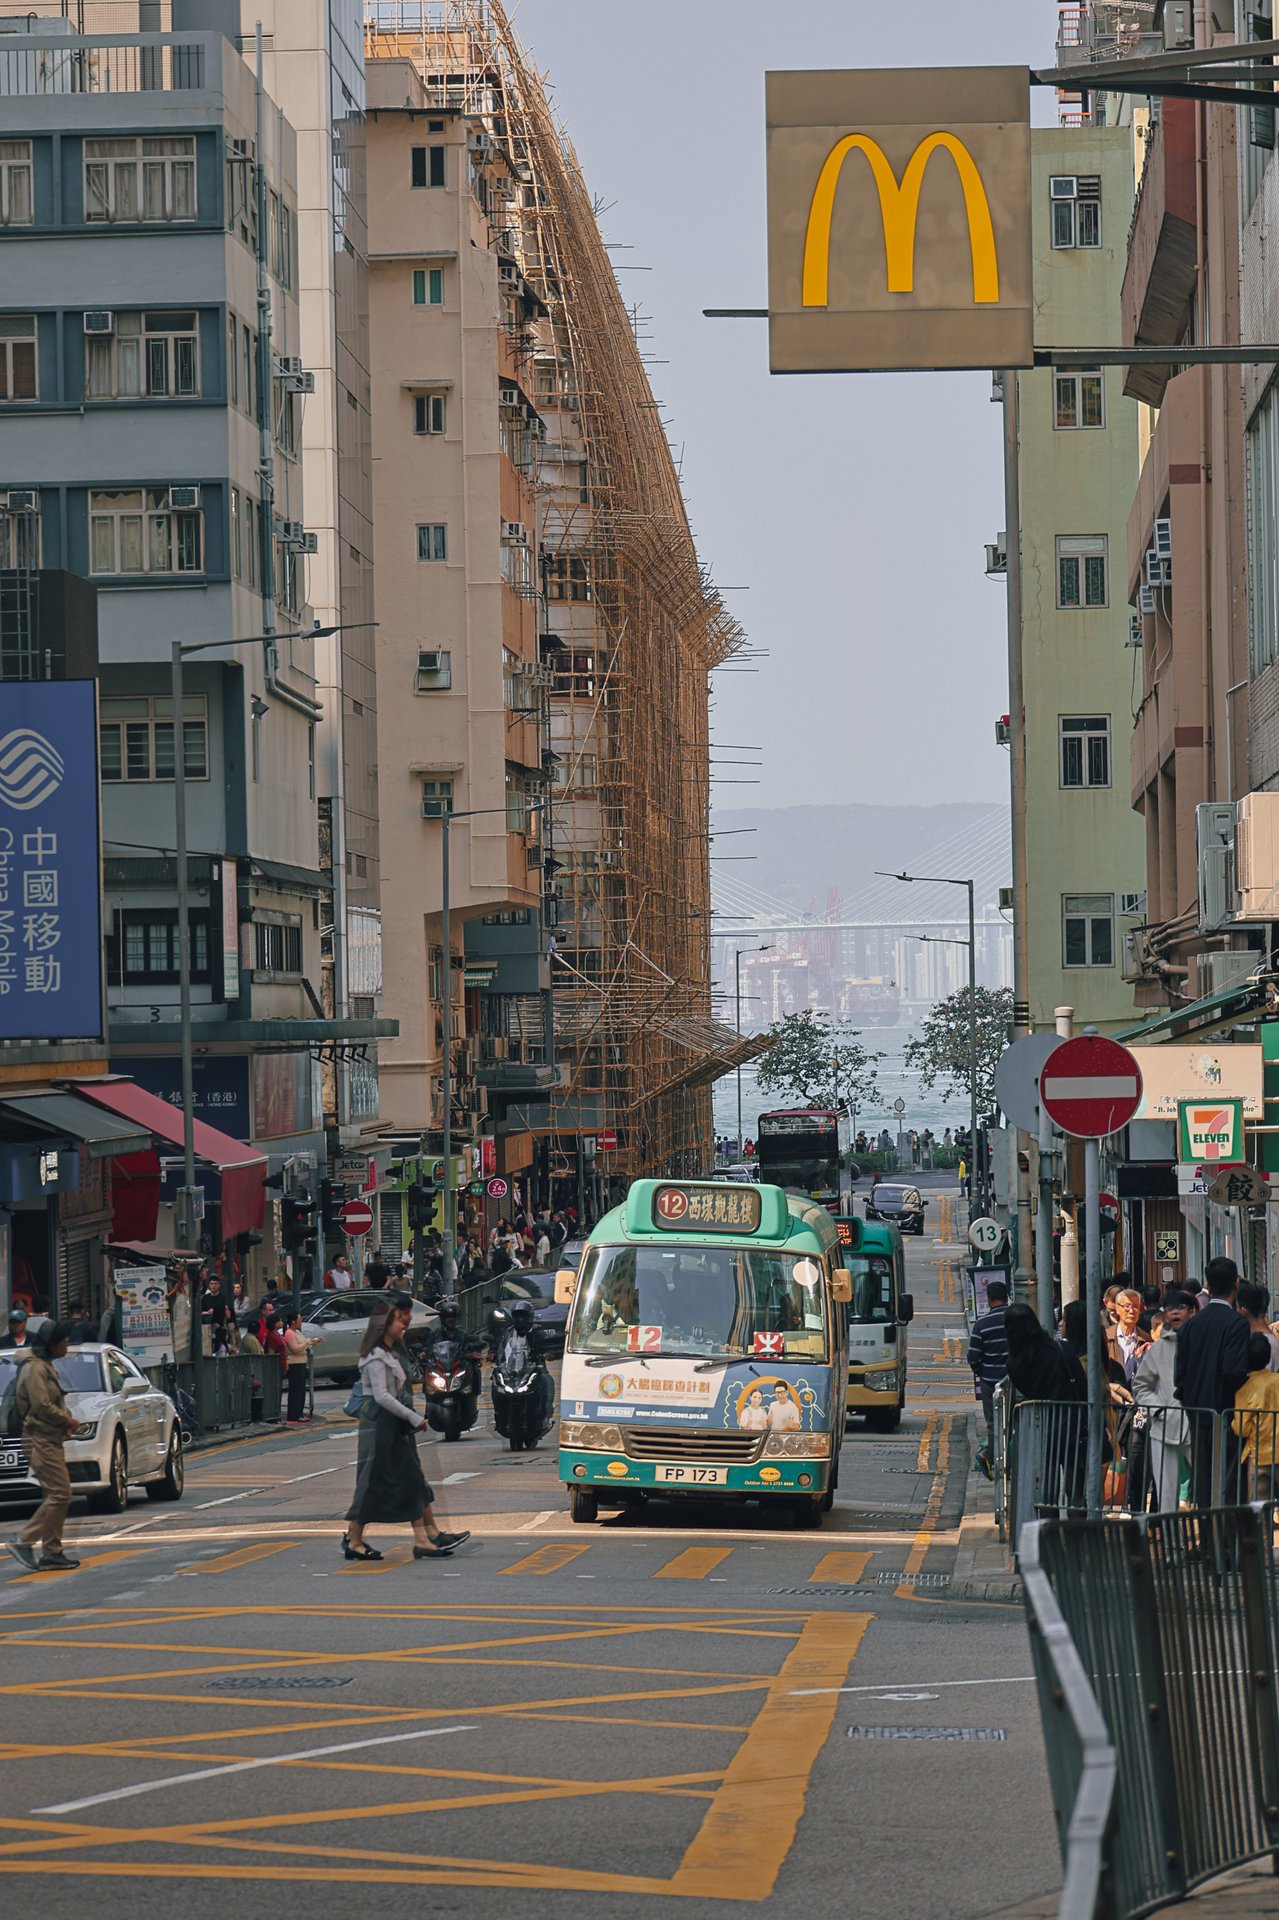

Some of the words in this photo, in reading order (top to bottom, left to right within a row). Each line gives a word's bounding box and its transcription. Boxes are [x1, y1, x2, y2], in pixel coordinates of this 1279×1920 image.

[22, 826, 61, 993] 中國移動
[1225, 1173, 1254, 1203] 餃
[661, 1194, 683, 1214] 12
[976, 1225, 997, 1242] 13
[628, 1327, 661, 1351] 12
[665, 1468, 685, 1480] FP
[692, 1469, 718, 1482] 173
